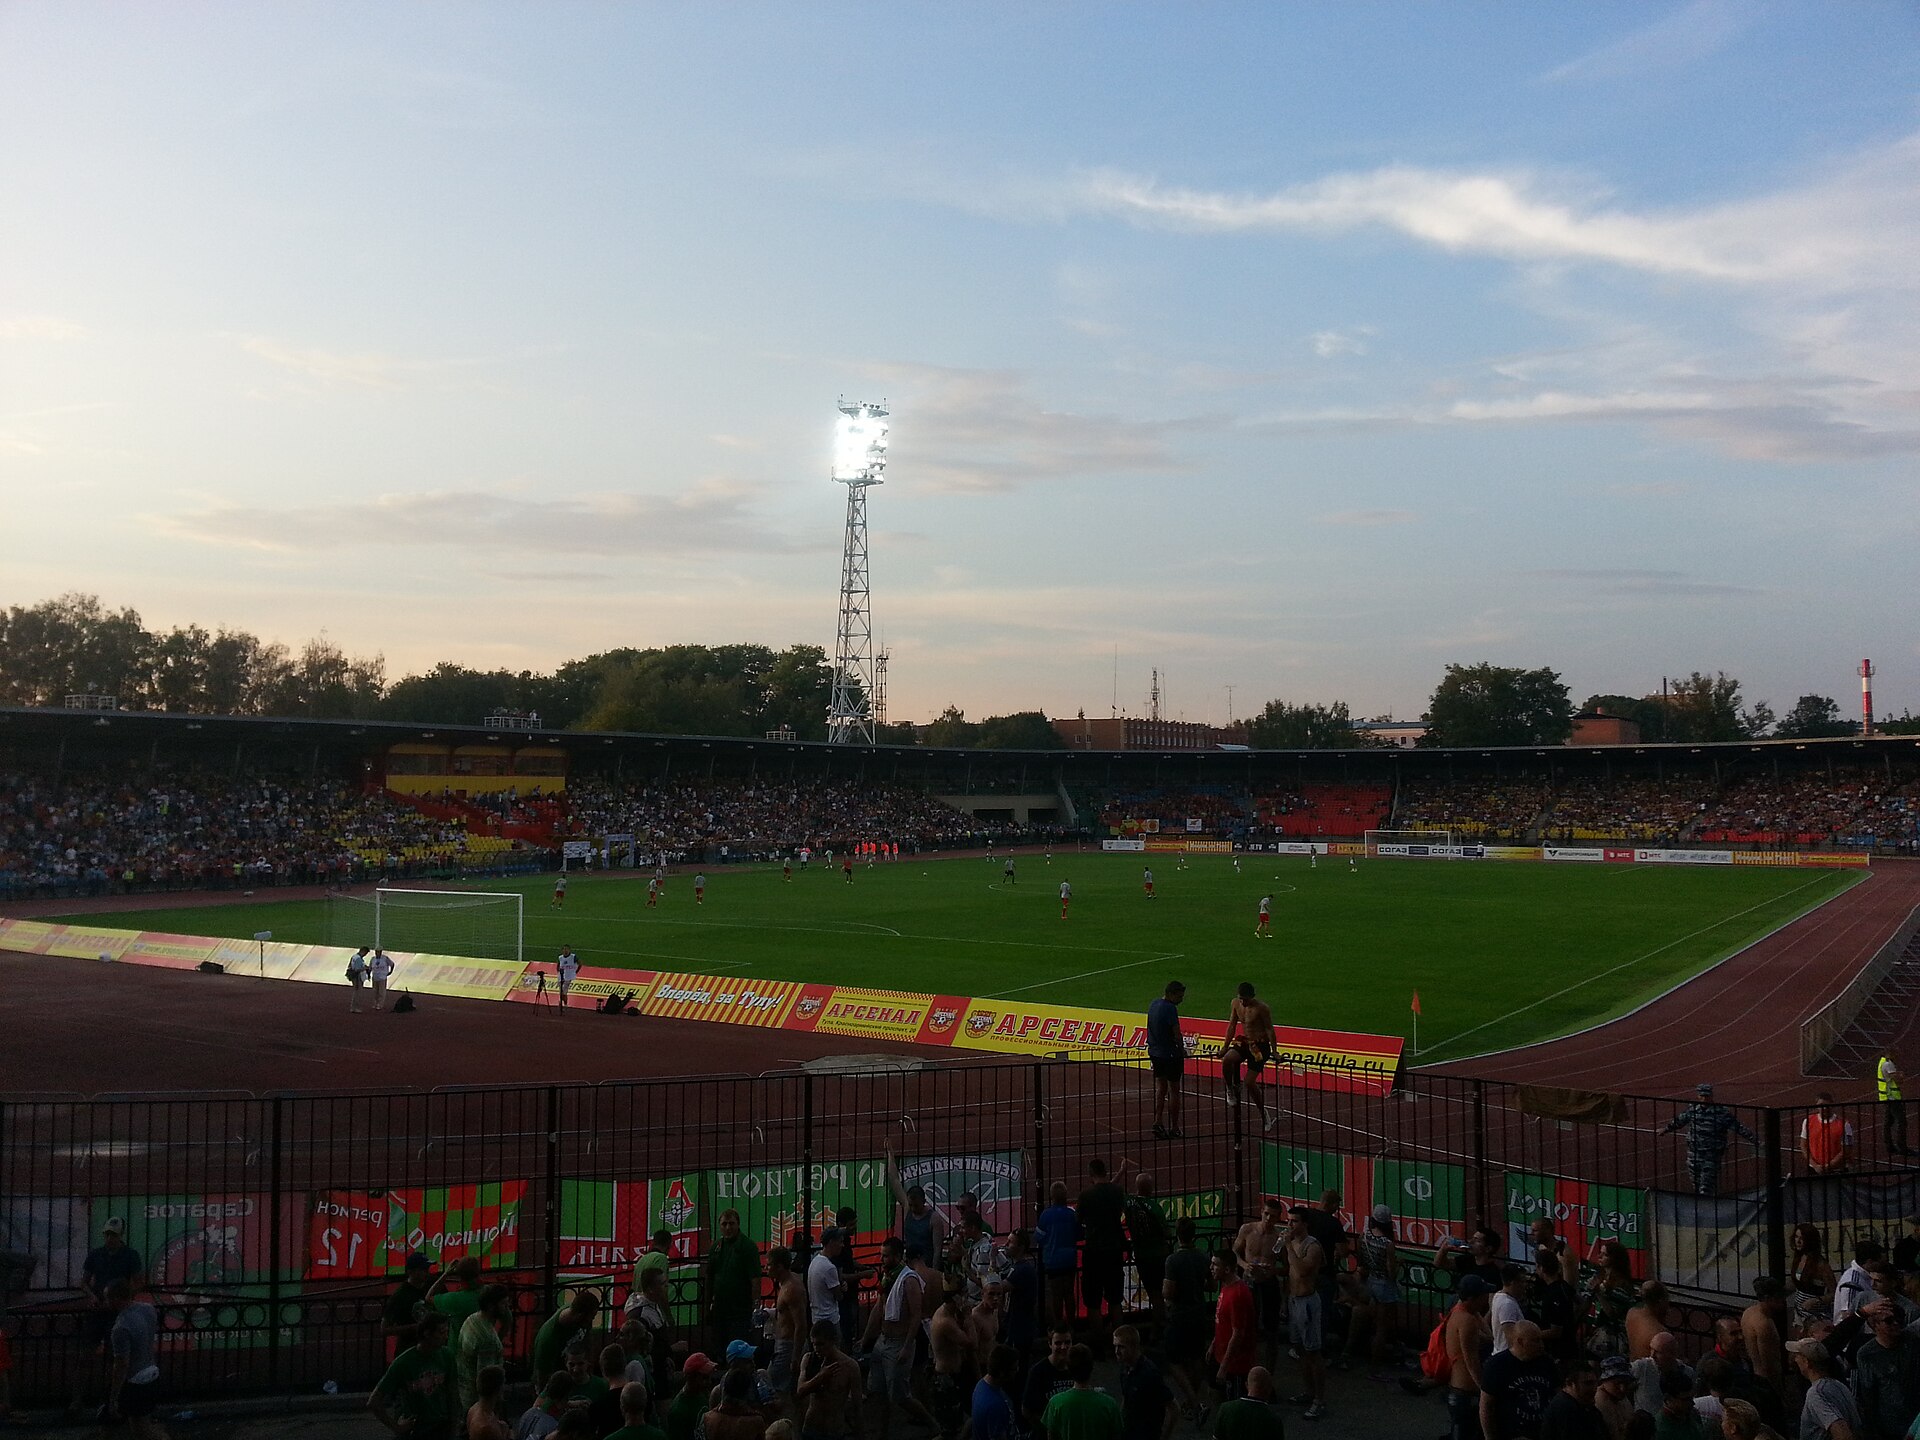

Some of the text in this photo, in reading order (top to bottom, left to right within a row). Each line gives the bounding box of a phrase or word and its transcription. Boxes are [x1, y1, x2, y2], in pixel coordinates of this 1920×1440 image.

[655, 984, 784, 1011] Вперёд, за Тулу!
[826, 1002, 922, 1024] АРСЕНАЛ
[990, 1035, 1069, 1048] ПРОФЕССИОНАЛЬНЫЙ
[993, 1013, 1147, 1049] АРСЕНАЛ
